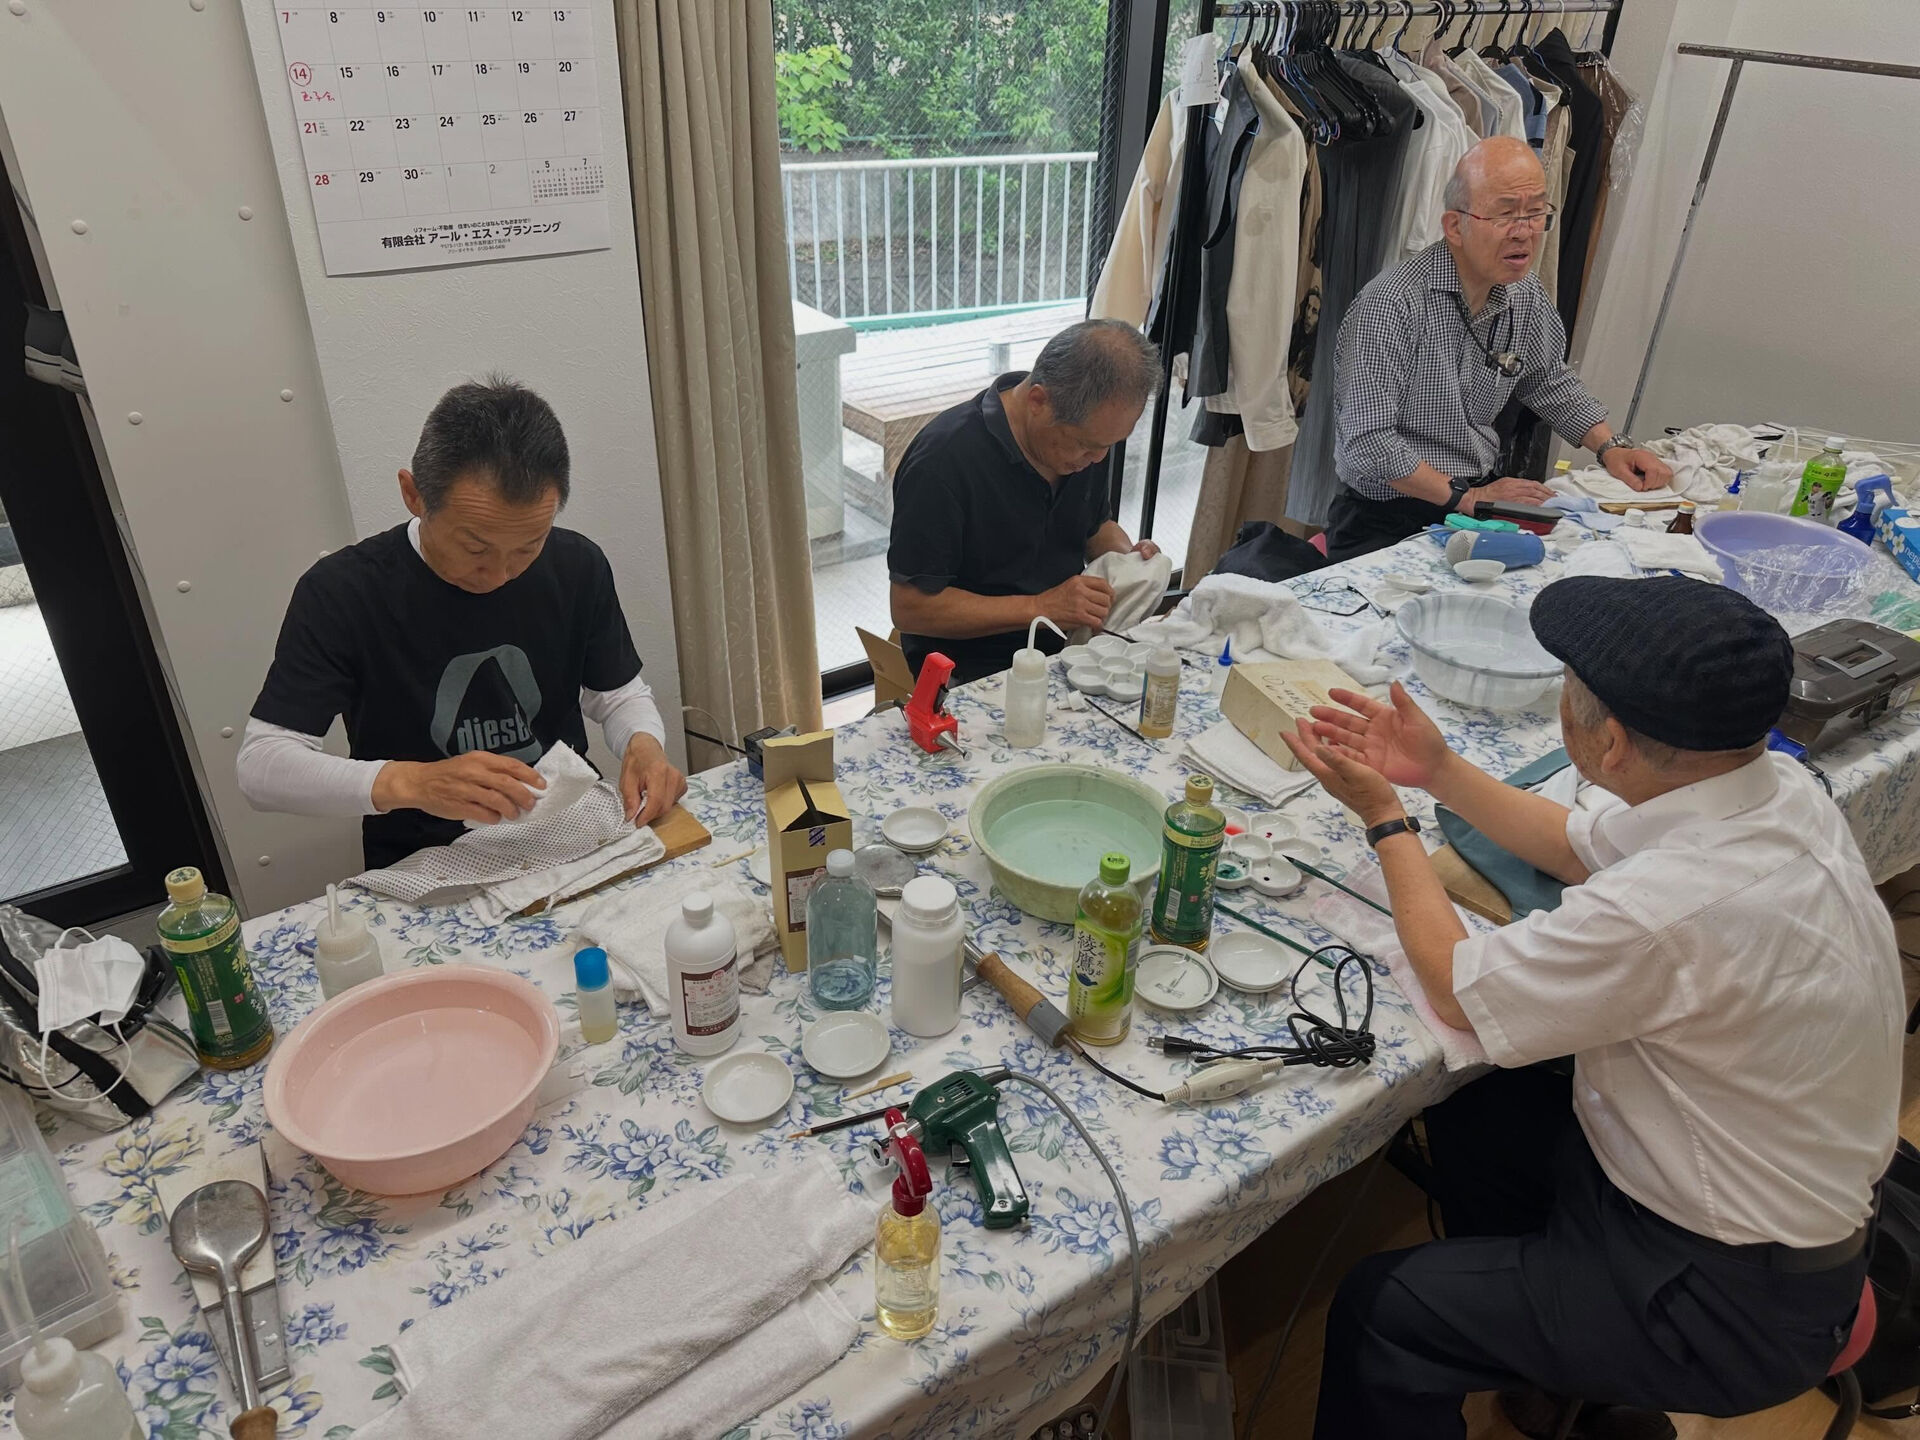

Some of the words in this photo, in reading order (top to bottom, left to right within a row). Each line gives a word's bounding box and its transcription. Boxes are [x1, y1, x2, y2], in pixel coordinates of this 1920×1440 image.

[281, 11, 289, 24] 7
[329, 11, 338, 24] 8
[377, 11, 386, 23] 9
[423, 11, 437, 23] 10
[467, 11, 479, 22] 11
[511, 11, 524, 22] 12
[553, 10, 566, 22] 13
[292, 68, 307, 80] 14
[339, 66, 354, 79] 15
[386, 65, 400, 78] 16
[431, 64, 444, 77] 17
[475, 63, 488, 75] 18
[517, 62, 530, 74] 19
[558, 61, 572, 73] 20
[303, 122, 318, 134] 21
[349, 119, 366, 132] 22
[394, 117, 410, 130] 23
[439, 115, 454, 128] 24
[482, 114, 497, 126] 25
[523, 112, 538, 124] 26
[563, 110, 577, 122] 27
[314, 174, 330, 186] 28
[358, 171, 375, 184] 29
[403, 168, 419, 181] 30
[489, 163, 497, 175] 2
[544, 160, 551, 169] 5
[582, 157, 588, 166] 7
[381, 234, 426, 249] 有限会社
[428, 221, 561, 244] アール・エス・プランニング
[1075, 930, 1097, 977] 綾鷹
